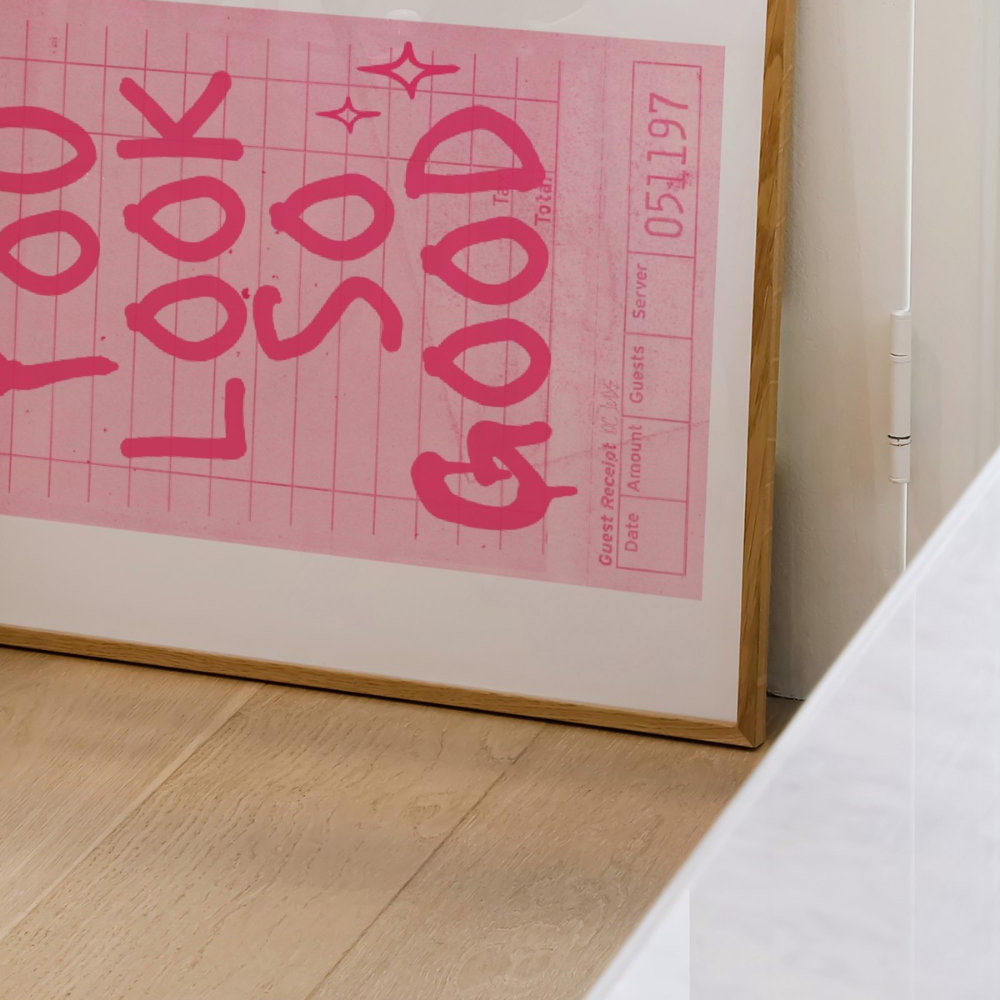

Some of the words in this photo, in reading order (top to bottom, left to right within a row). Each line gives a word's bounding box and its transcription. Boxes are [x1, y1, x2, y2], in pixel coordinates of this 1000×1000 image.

[644, 92, 689, 239] 051197
[116, 70, 248, 461] LOOK
[252, 173, 403, 361] SO
[631, 262, 648, 319] Server
[405, 105, 579, 531] GOOD
[629, 345, 645, 404] Guests
[601, 442, 618, 512] Receipt
[626, 424, 643, 492] Amount
[599, 516, 615, 567] Guest
[624, 512, 640, 553] Date
